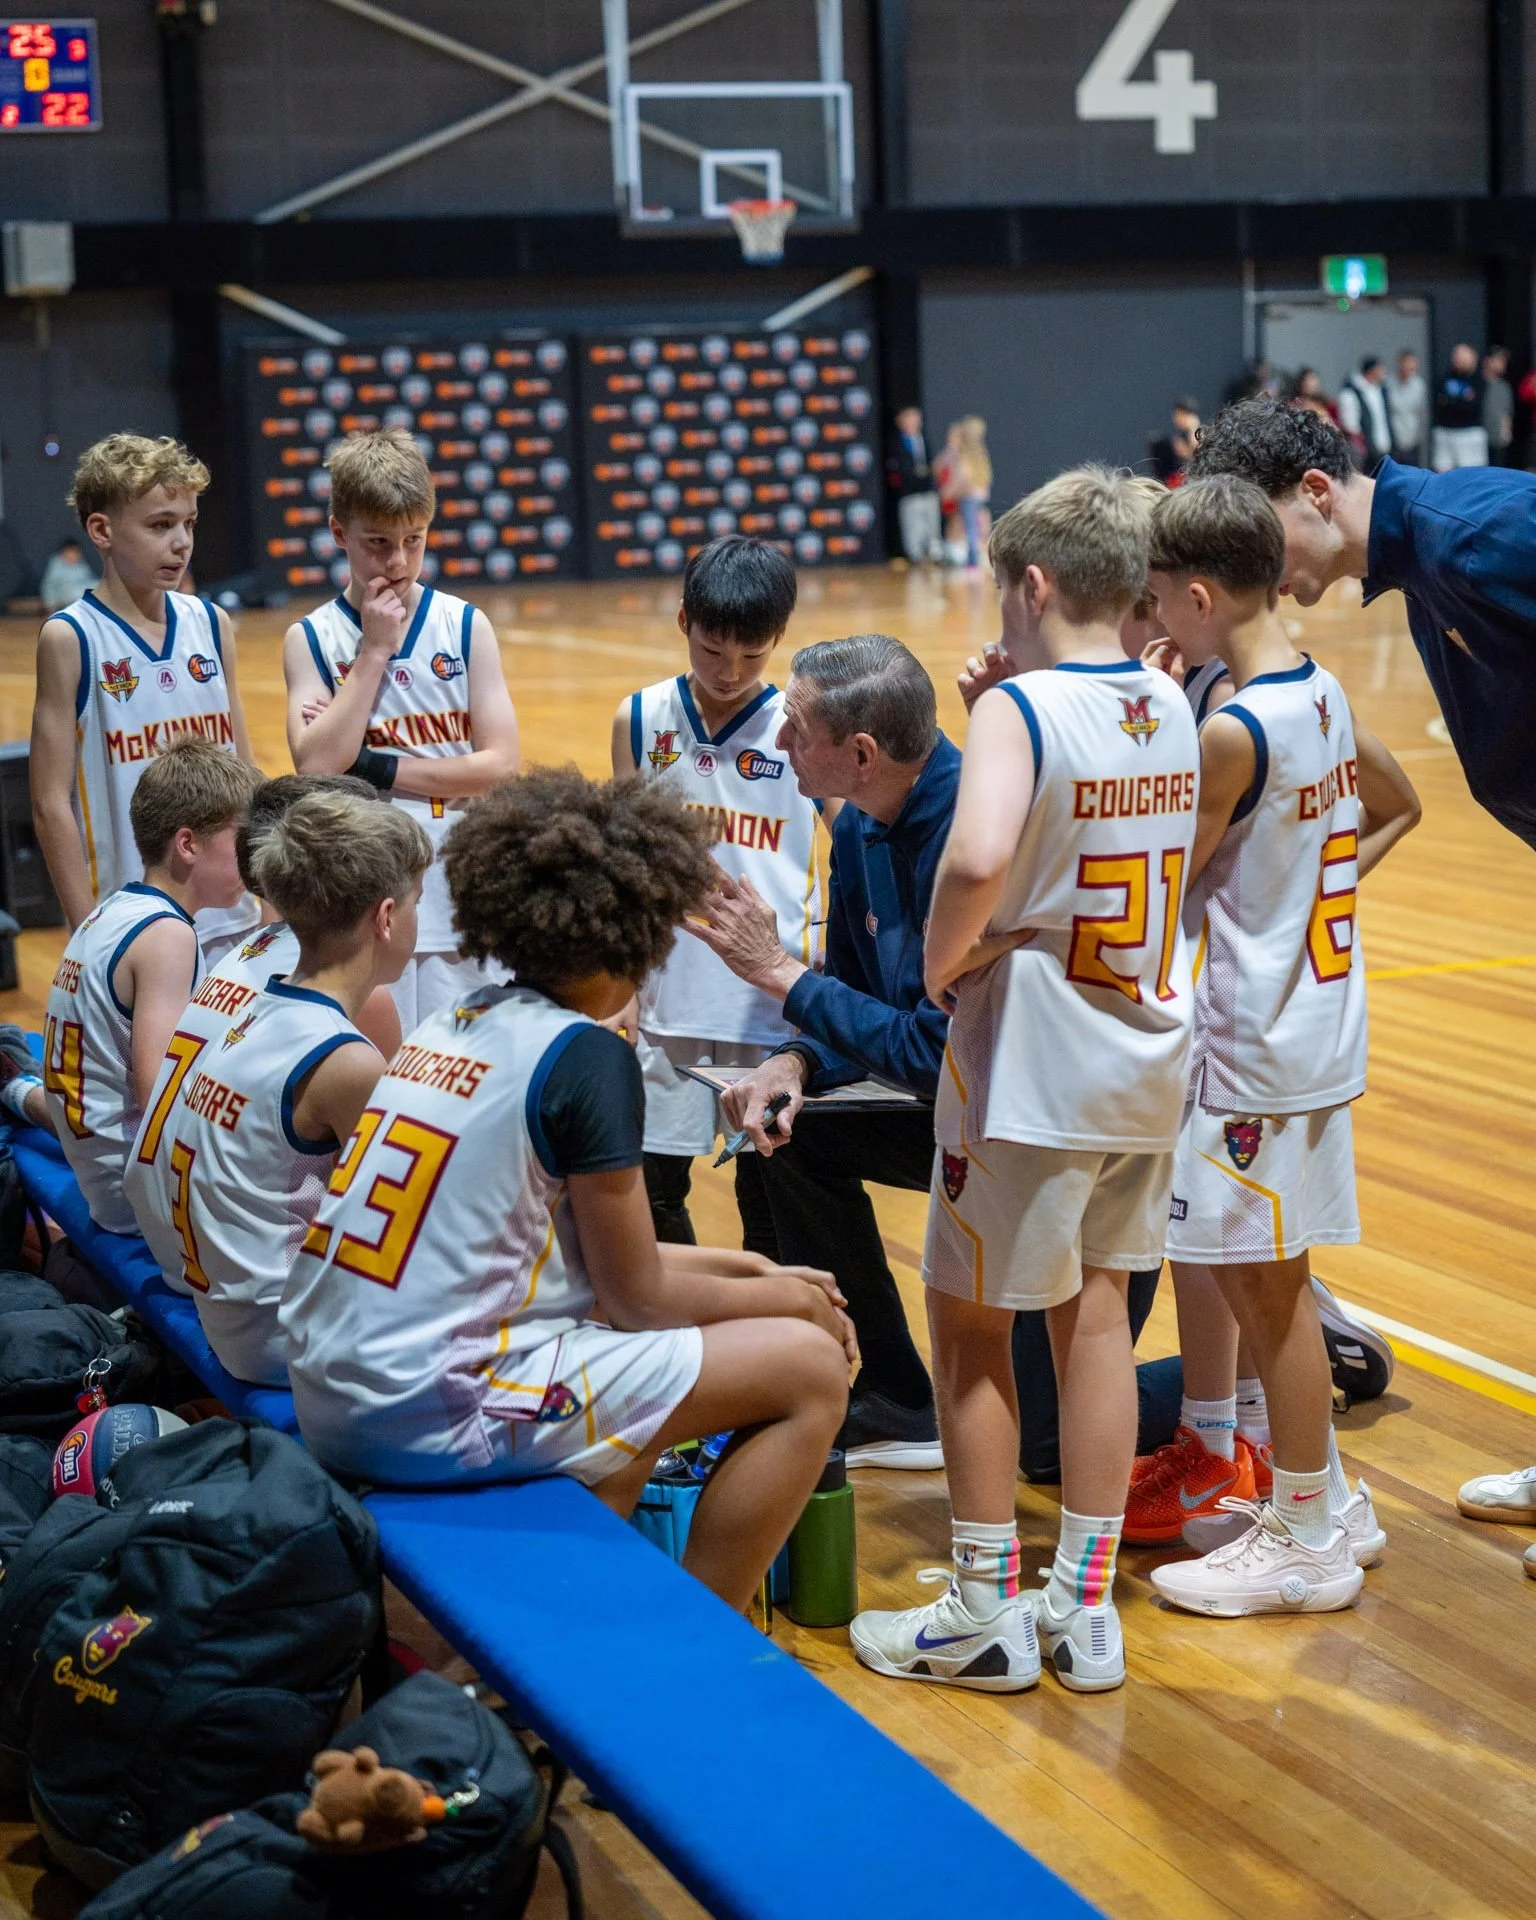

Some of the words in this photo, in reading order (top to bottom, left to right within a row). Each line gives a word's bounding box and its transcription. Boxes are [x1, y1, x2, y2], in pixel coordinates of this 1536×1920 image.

[8, 23, 56, 58] 25
[1075, 0, 1218, 155] 4
[41, 92, 90, 127] 22
[752, 760, 780, 777] VJBL
[1071, 772, 1195, 820] COUGARS
[1065, 847, 1187, 1005] 21
[137, 1030, 209, 1166] 7
[63, 1446, 76, 1480] VJBL
[53, 1655, 118, 1704] Cougars
